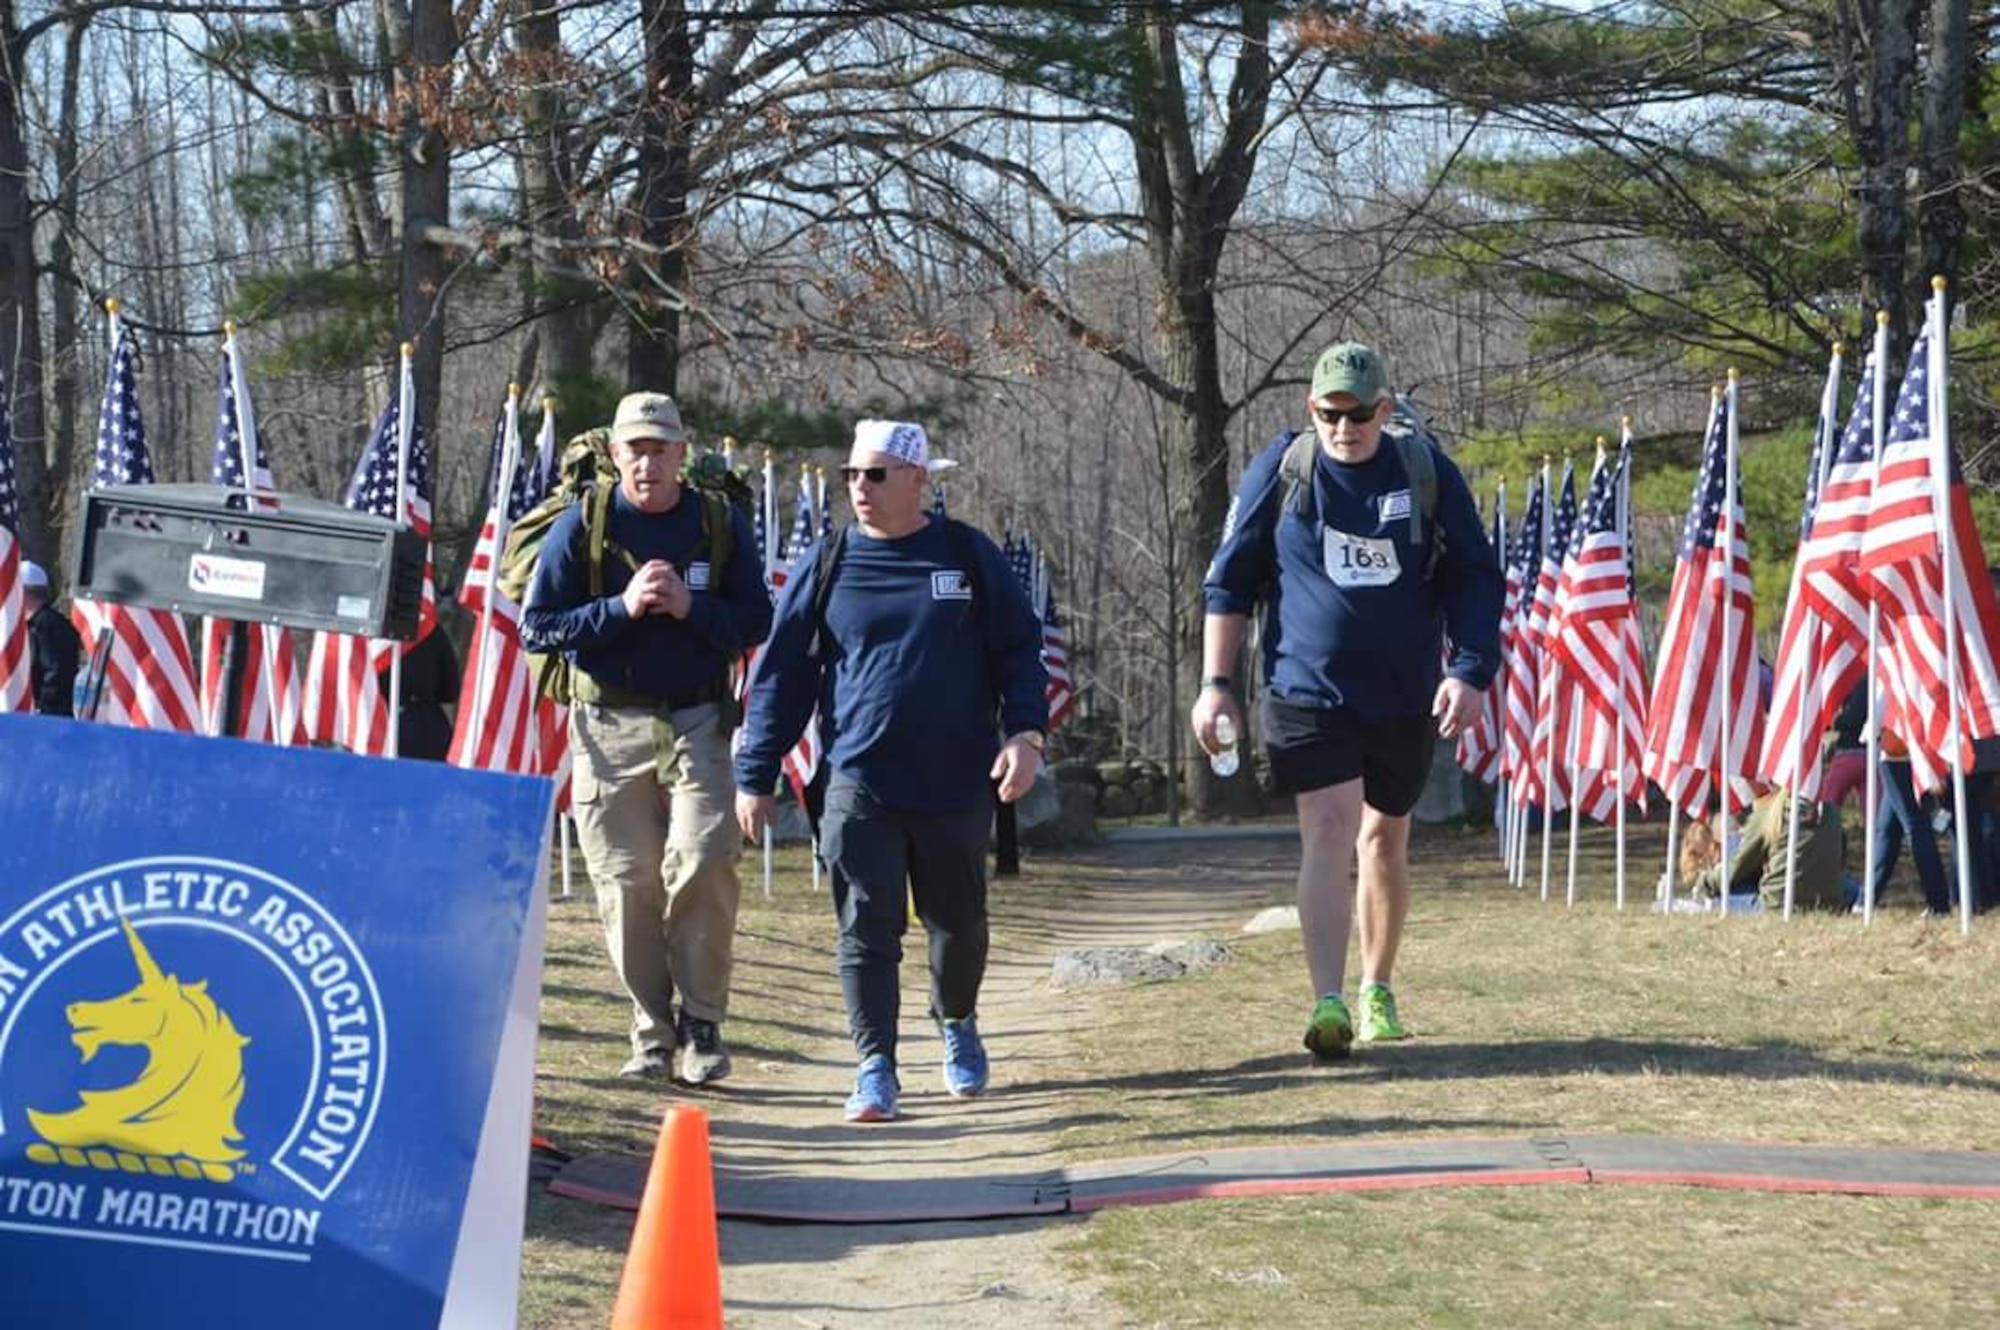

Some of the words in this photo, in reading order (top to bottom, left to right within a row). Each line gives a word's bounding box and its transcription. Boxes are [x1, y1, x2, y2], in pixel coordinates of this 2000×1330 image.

[21, 872, 250, 961] ATHLETIC
[249, 895, 370, 1171] ASSOCIATION
[0, 1177, 87, 1220] TON
[95, 1186, 321, 1246] MARATHON
